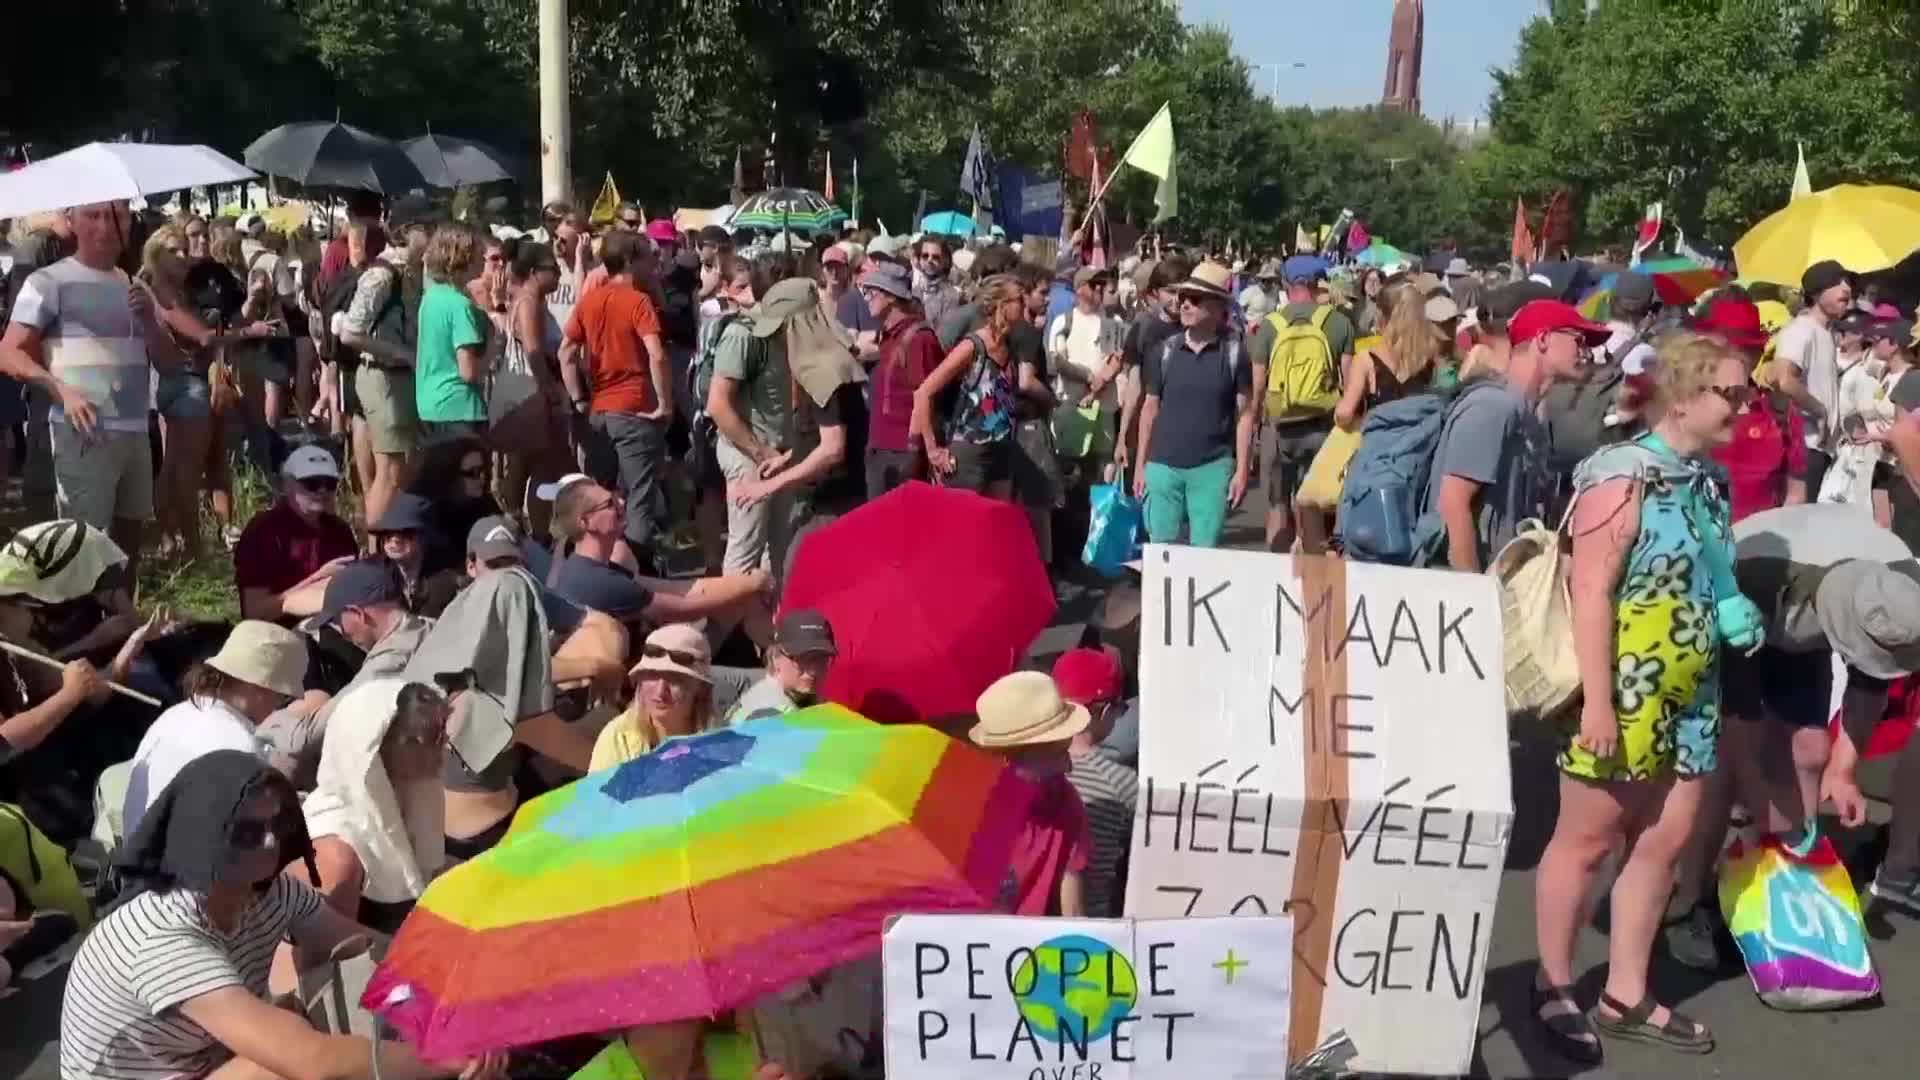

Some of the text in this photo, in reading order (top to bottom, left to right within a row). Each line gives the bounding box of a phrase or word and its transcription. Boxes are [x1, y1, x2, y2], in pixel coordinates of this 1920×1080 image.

[1275, 583, 1485, 681] MAAK
[1268, 685, 1376, 759] ME
[1144, 758, 1489, 870] HÉÉL VÉÉL
[914, 941, 1176, 1000] PEOPLE
[1155, 885, 1482, 1000] RGEN
[916, 1009, 1195, 1063] PLANET
